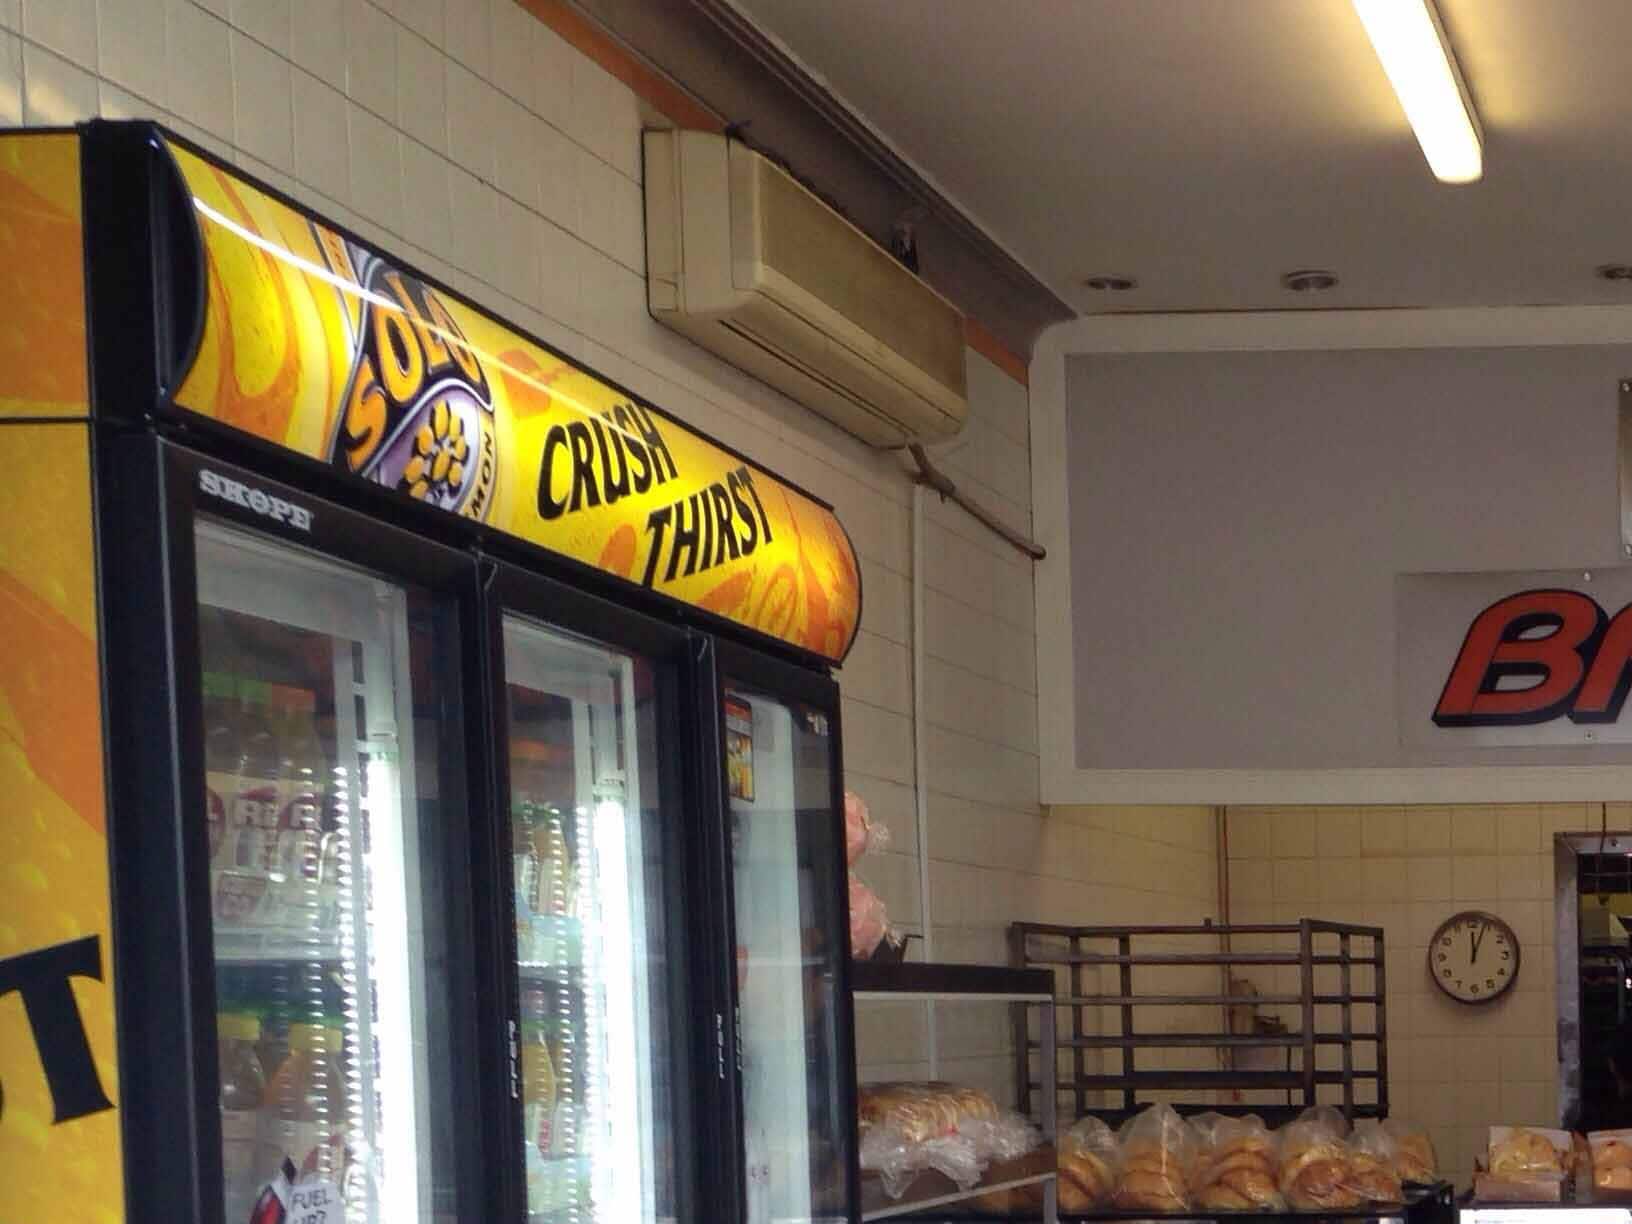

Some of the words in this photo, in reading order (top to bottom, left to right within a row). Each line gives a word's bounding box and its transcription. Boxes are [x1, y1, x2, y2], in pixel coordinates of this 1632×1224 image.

[344, 270, 483, 474] SOLO
[198, 468, 312, 532] SKOPE
[537, 401, 679, 520] CRUSH
[642, 464, 774, 588] THIRST
[292, 1188, 330, 1213] FUEL
